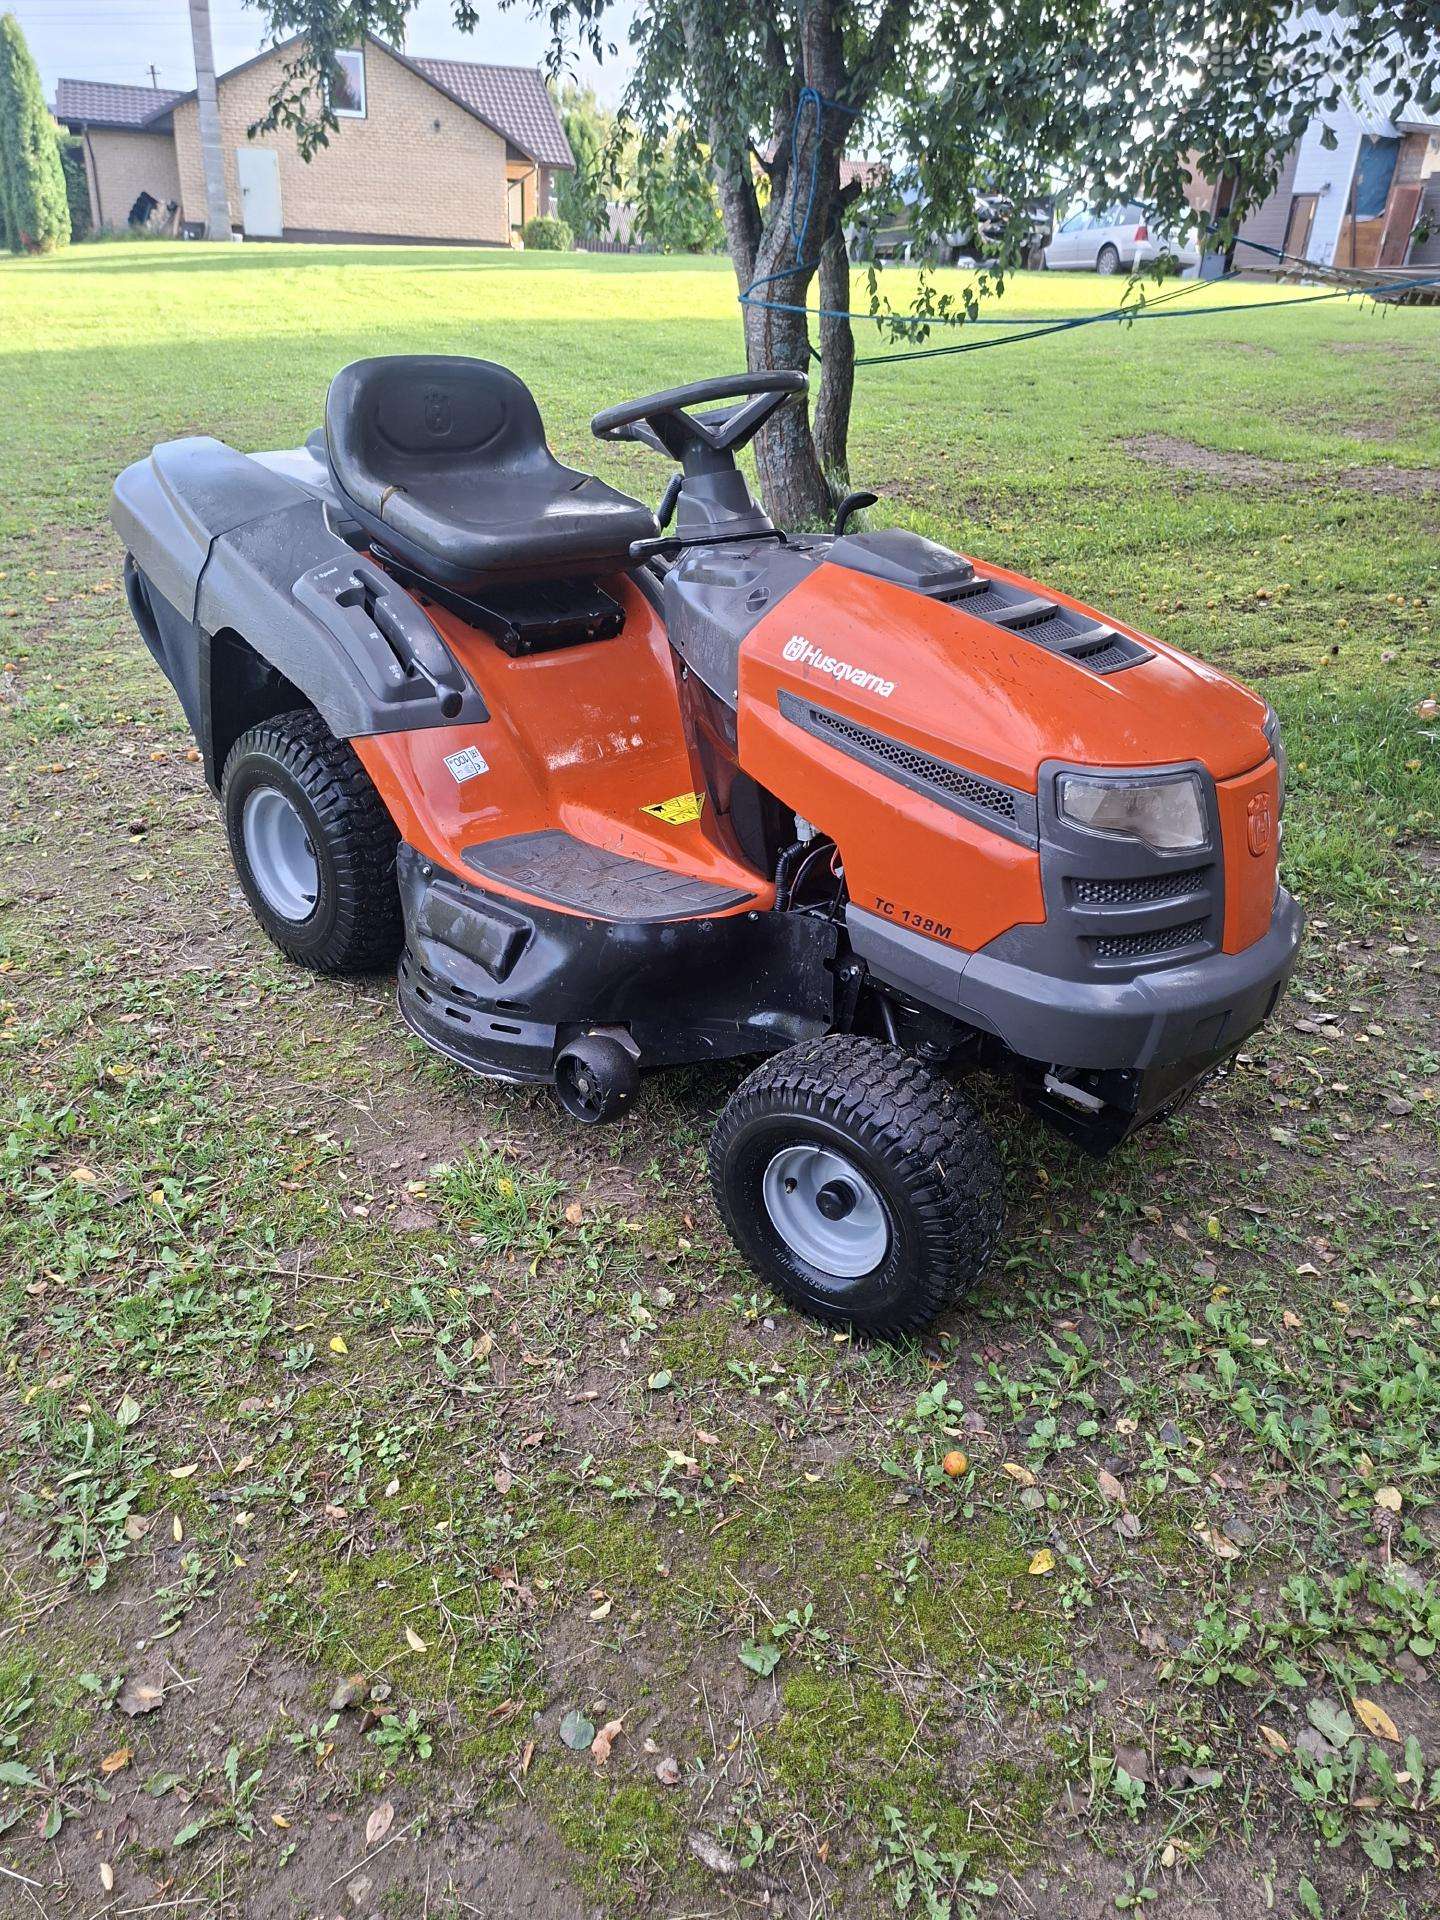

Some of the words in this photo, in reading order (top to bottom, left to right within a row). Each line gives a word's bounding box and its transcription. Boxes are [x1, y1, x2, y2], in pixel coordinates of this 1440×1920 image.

[799, 644, 895, 698] Husqvarna
[875, 896, 895, 915] TC
[902, 910, 952, 939] 138M
